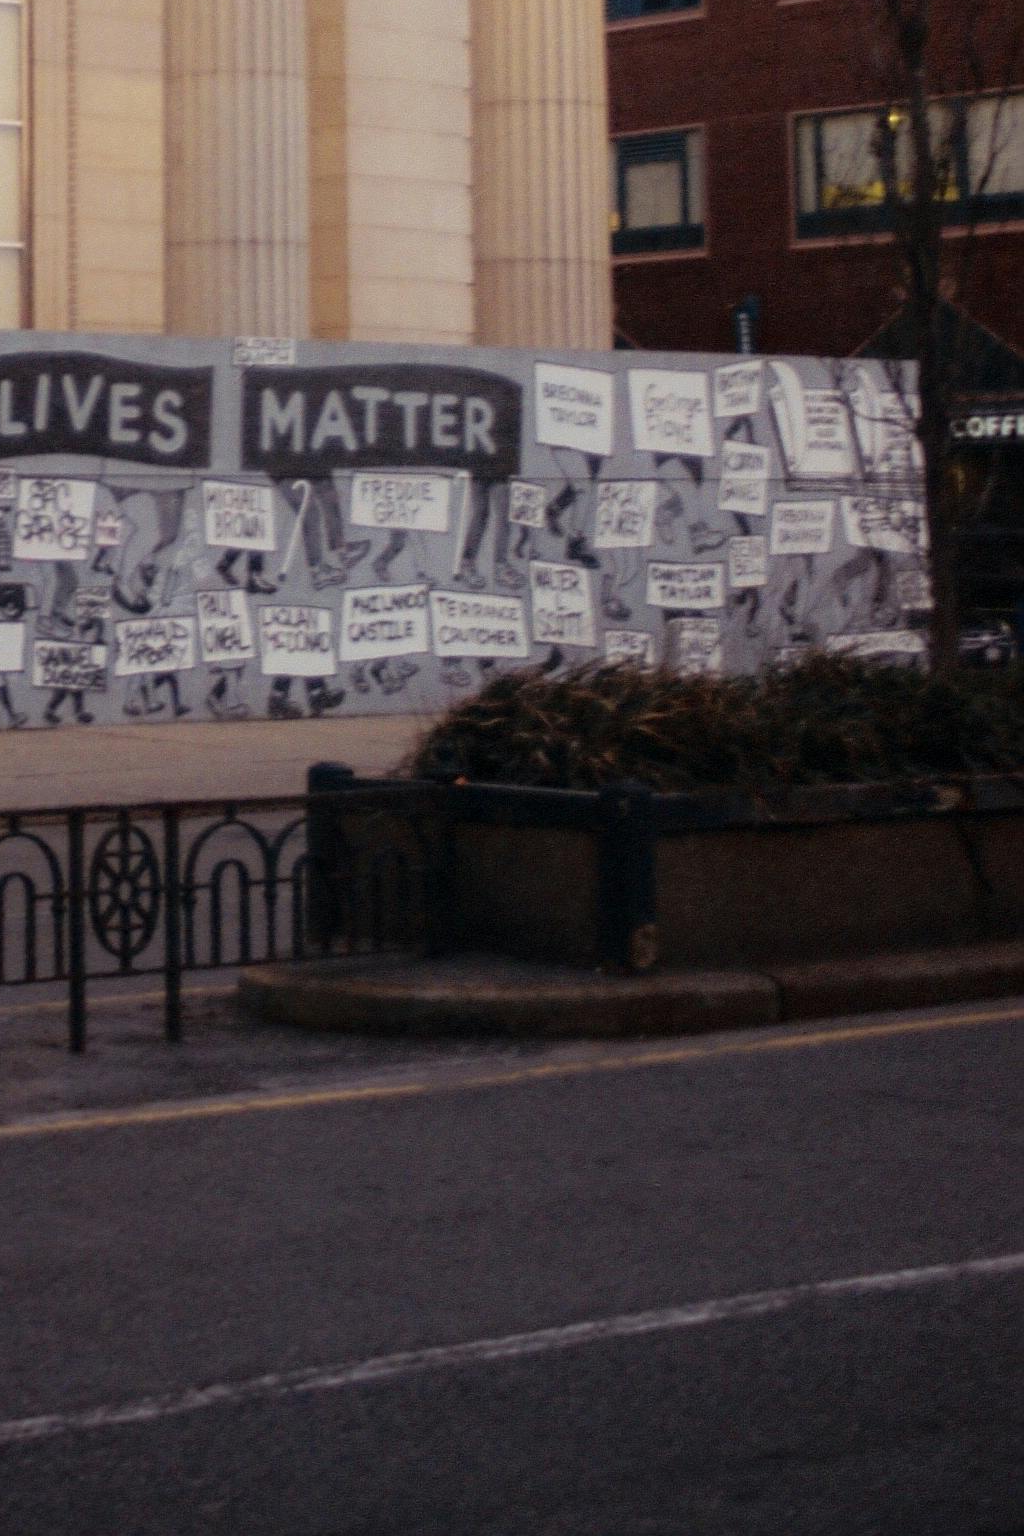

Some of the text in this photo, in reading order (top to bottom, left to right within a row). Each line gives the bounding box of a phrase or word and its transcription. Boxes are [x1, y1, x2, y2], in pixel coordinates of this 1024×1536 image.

[260, 385, 496, 454] MATTER
[548, 407, 599, 429] TAYLOR
[360, 479, 434, 502] FREDDIE
[374, 501, 420, 523] GRAY
[349, 619, 414, 643] CASTILE
[438, 624, 519, 647] CRUTCHER
